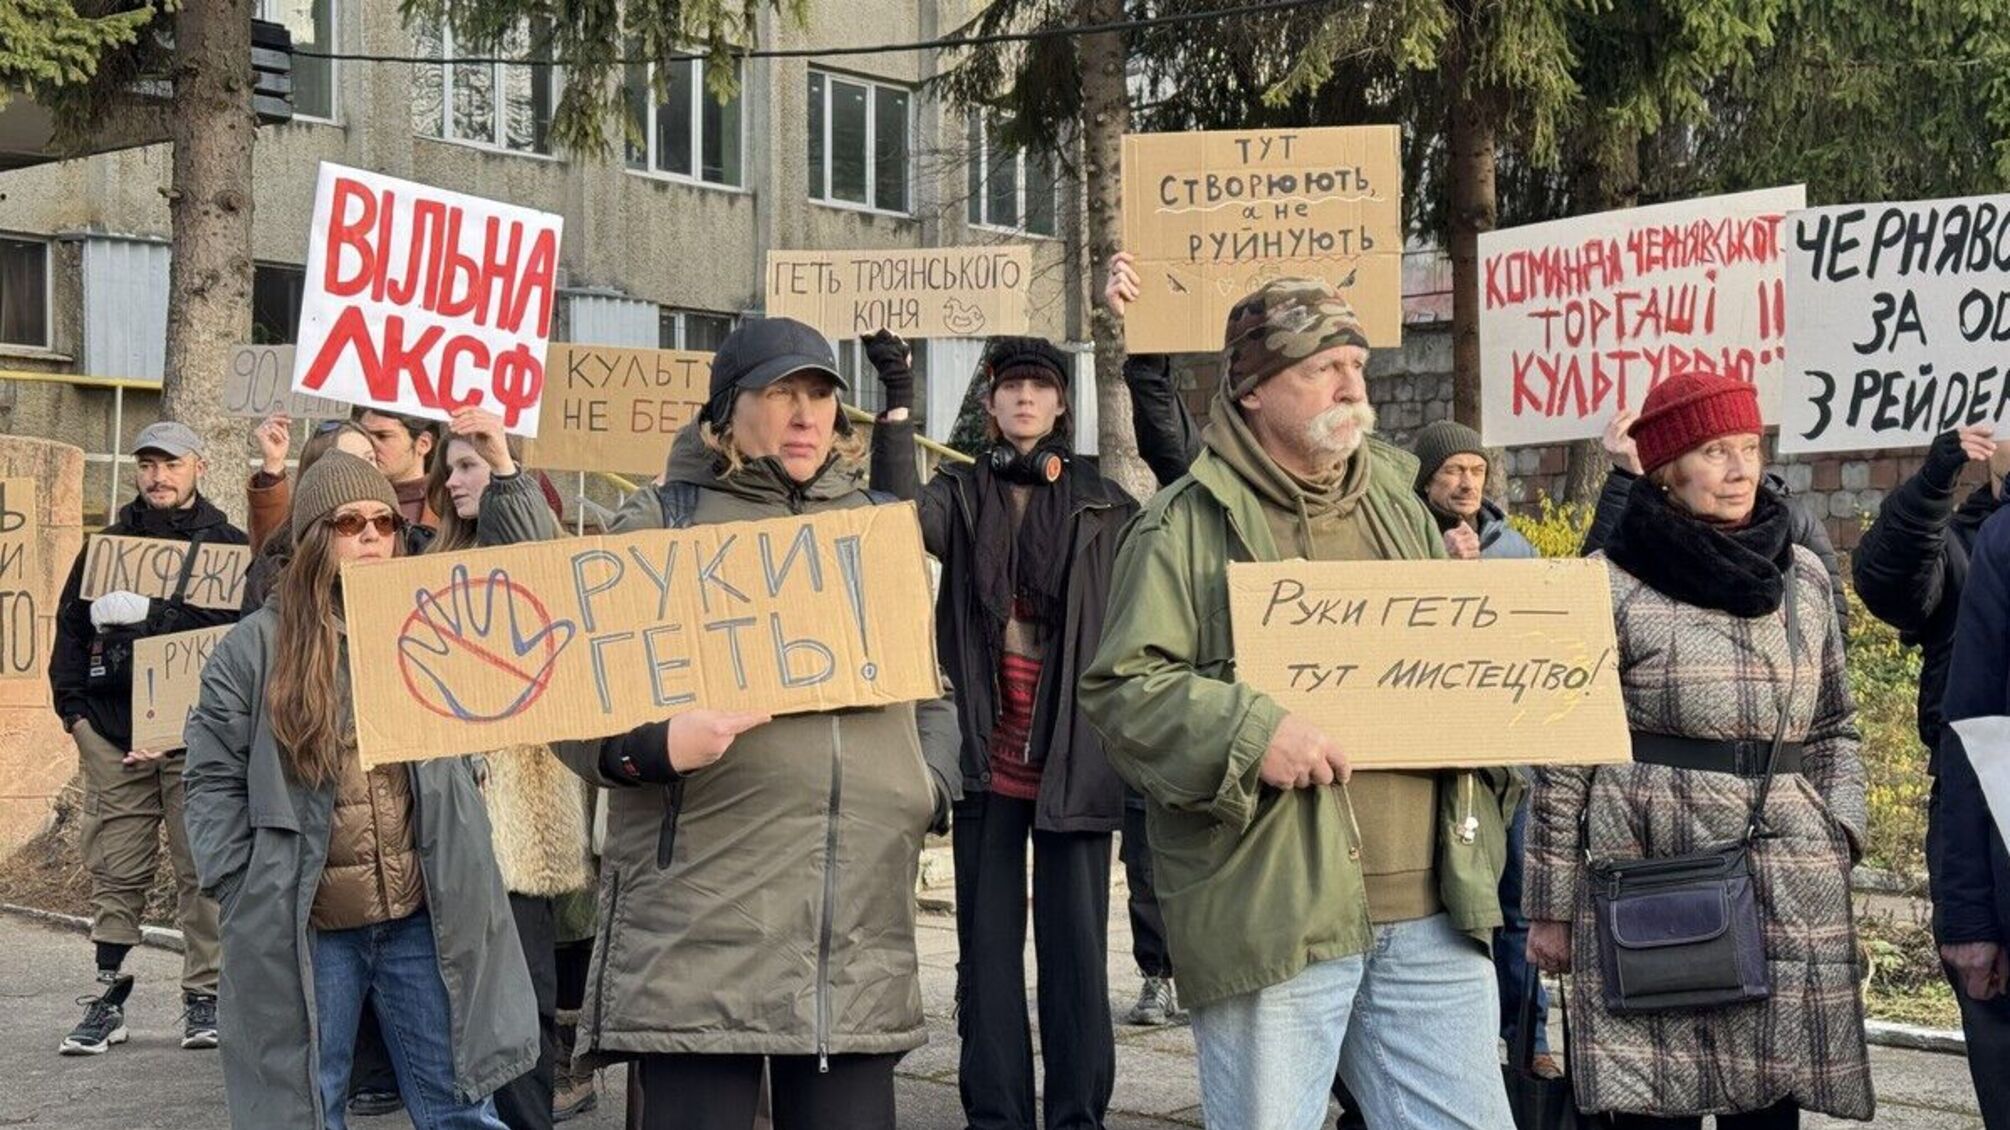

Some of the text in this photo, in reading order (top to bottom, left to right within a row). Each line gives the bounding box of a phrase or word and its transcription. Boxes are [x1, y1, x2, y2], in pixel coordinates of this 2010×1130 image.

[1235, 135, 1298, 164] ТУТ
[1160, 167, 1377, 205] СТВОРЮЮТЬ,
[1243, 205, 1261, 219] а
[324, 177, 556, 338] ВІЛЬНА
[1189, 225, 1374, 262] РУЙНУЮТЬ
[775, 253, 1020, 295] ГЕТЬ ТРОЯНСЬКОГО
[1486, 238, 1623, 310] КОМАНДА
[853, 298, 919, 332] КОНЯ
[1853, 289, 1927, 354] ЗА
[301, 305, 546, 428] ЛКСФ
[568, 350, 712, 389] КУЛЬТ
[563, 398, 608, 432] НЕ
[571, 523, 822, 631] РУКИ
[588, 613, 835, 714] ГЕТЬ
